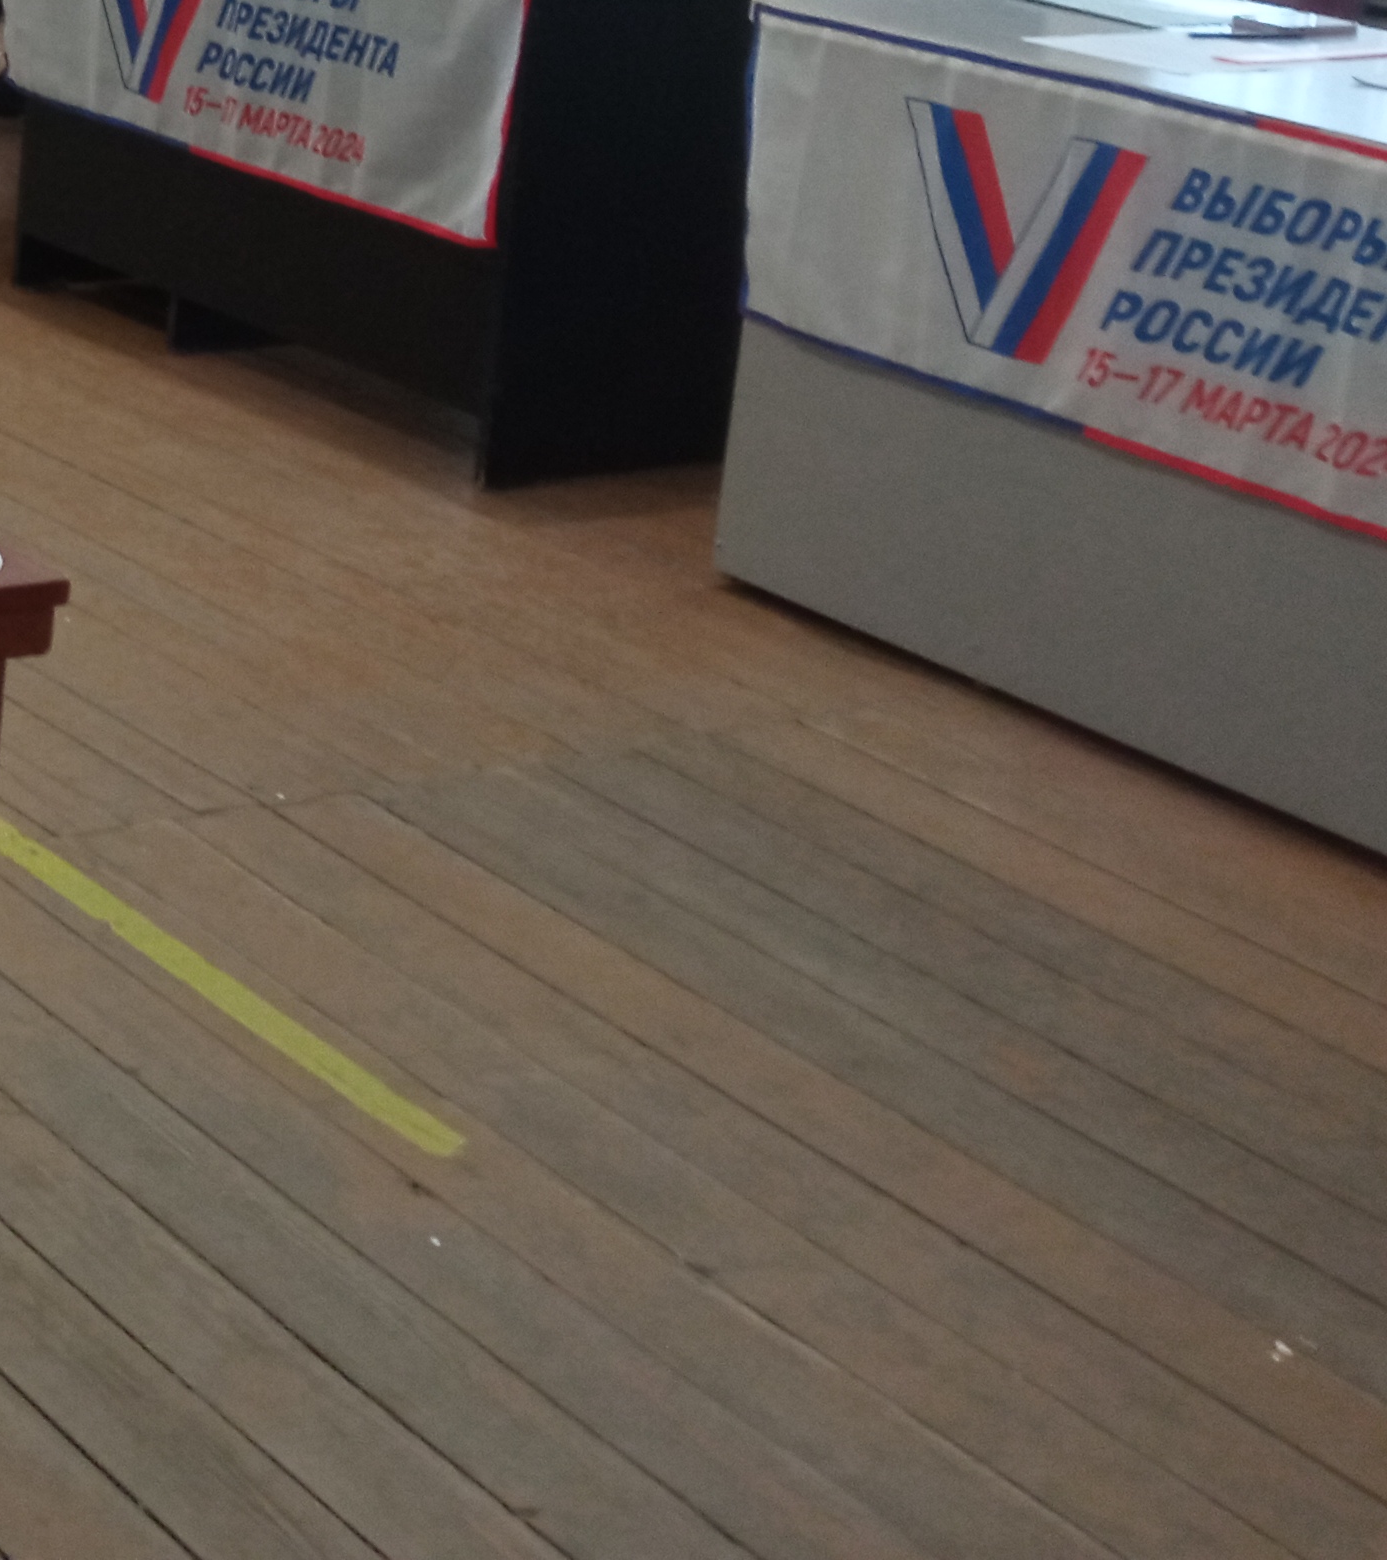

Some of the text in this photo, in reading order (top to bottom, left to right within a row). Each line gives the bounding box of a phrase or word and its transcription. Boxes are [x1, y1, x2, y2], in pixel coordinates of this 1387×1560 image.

[196, 41, 316, 103] РОССИИ
[237, 102, 313, 149] МАРТА
[313, 124, 365, 163] 2024
[1131, 229, 1387, 342] ПРЕЗИДЕ
[1099, 289, 1324, 388] РОССИИ
[1079, 348, 1387, 477] 15–17 МАРТА 202
